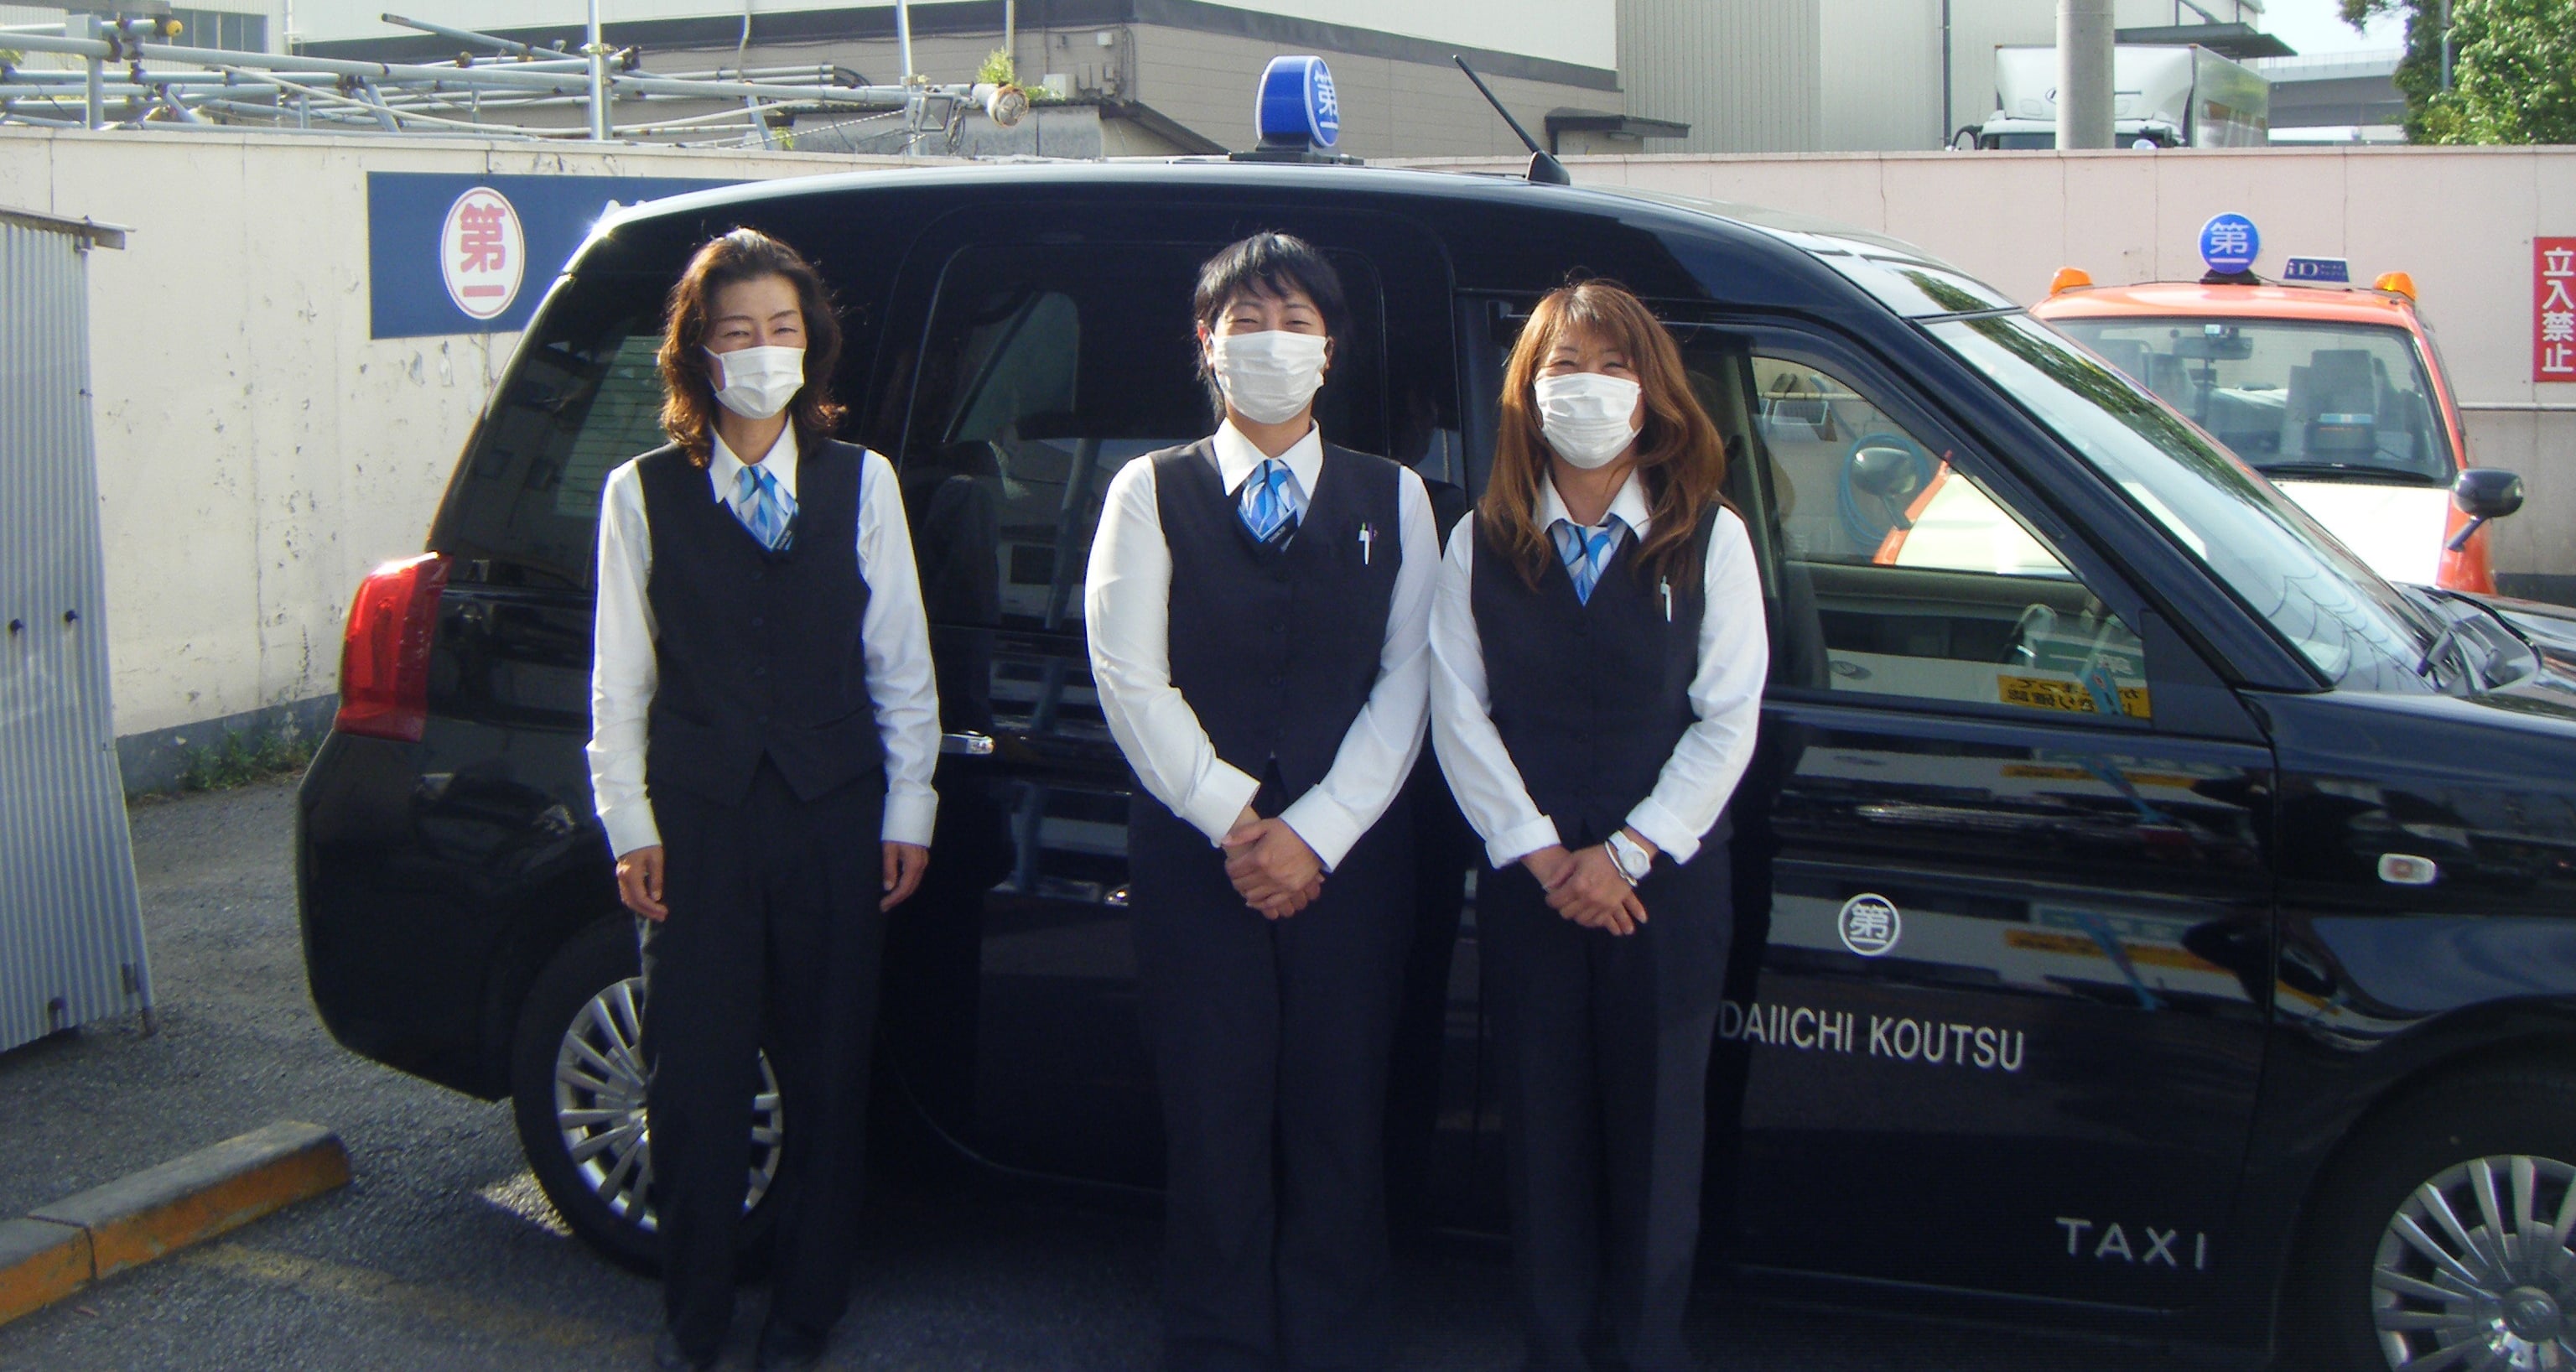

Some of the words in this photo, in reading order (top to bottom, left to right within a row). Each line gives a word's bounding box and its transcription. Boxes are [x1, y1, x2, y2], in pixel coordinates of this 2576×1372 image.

[460, 202, 506, 299] 第一
[2209, 221, 2250, 264] 第一
[2288, 262, 2319, 277] iD
[2542, 246, 2575, 373] 立入禁止
[1849, 902, 1888, 945] 第一
[1718, 1000, 1854, 1054] DAIICHI
[1868, 1014, 2025, 1072] KOUTSU
[2055, 1217, 2205, 1271] TAXI
